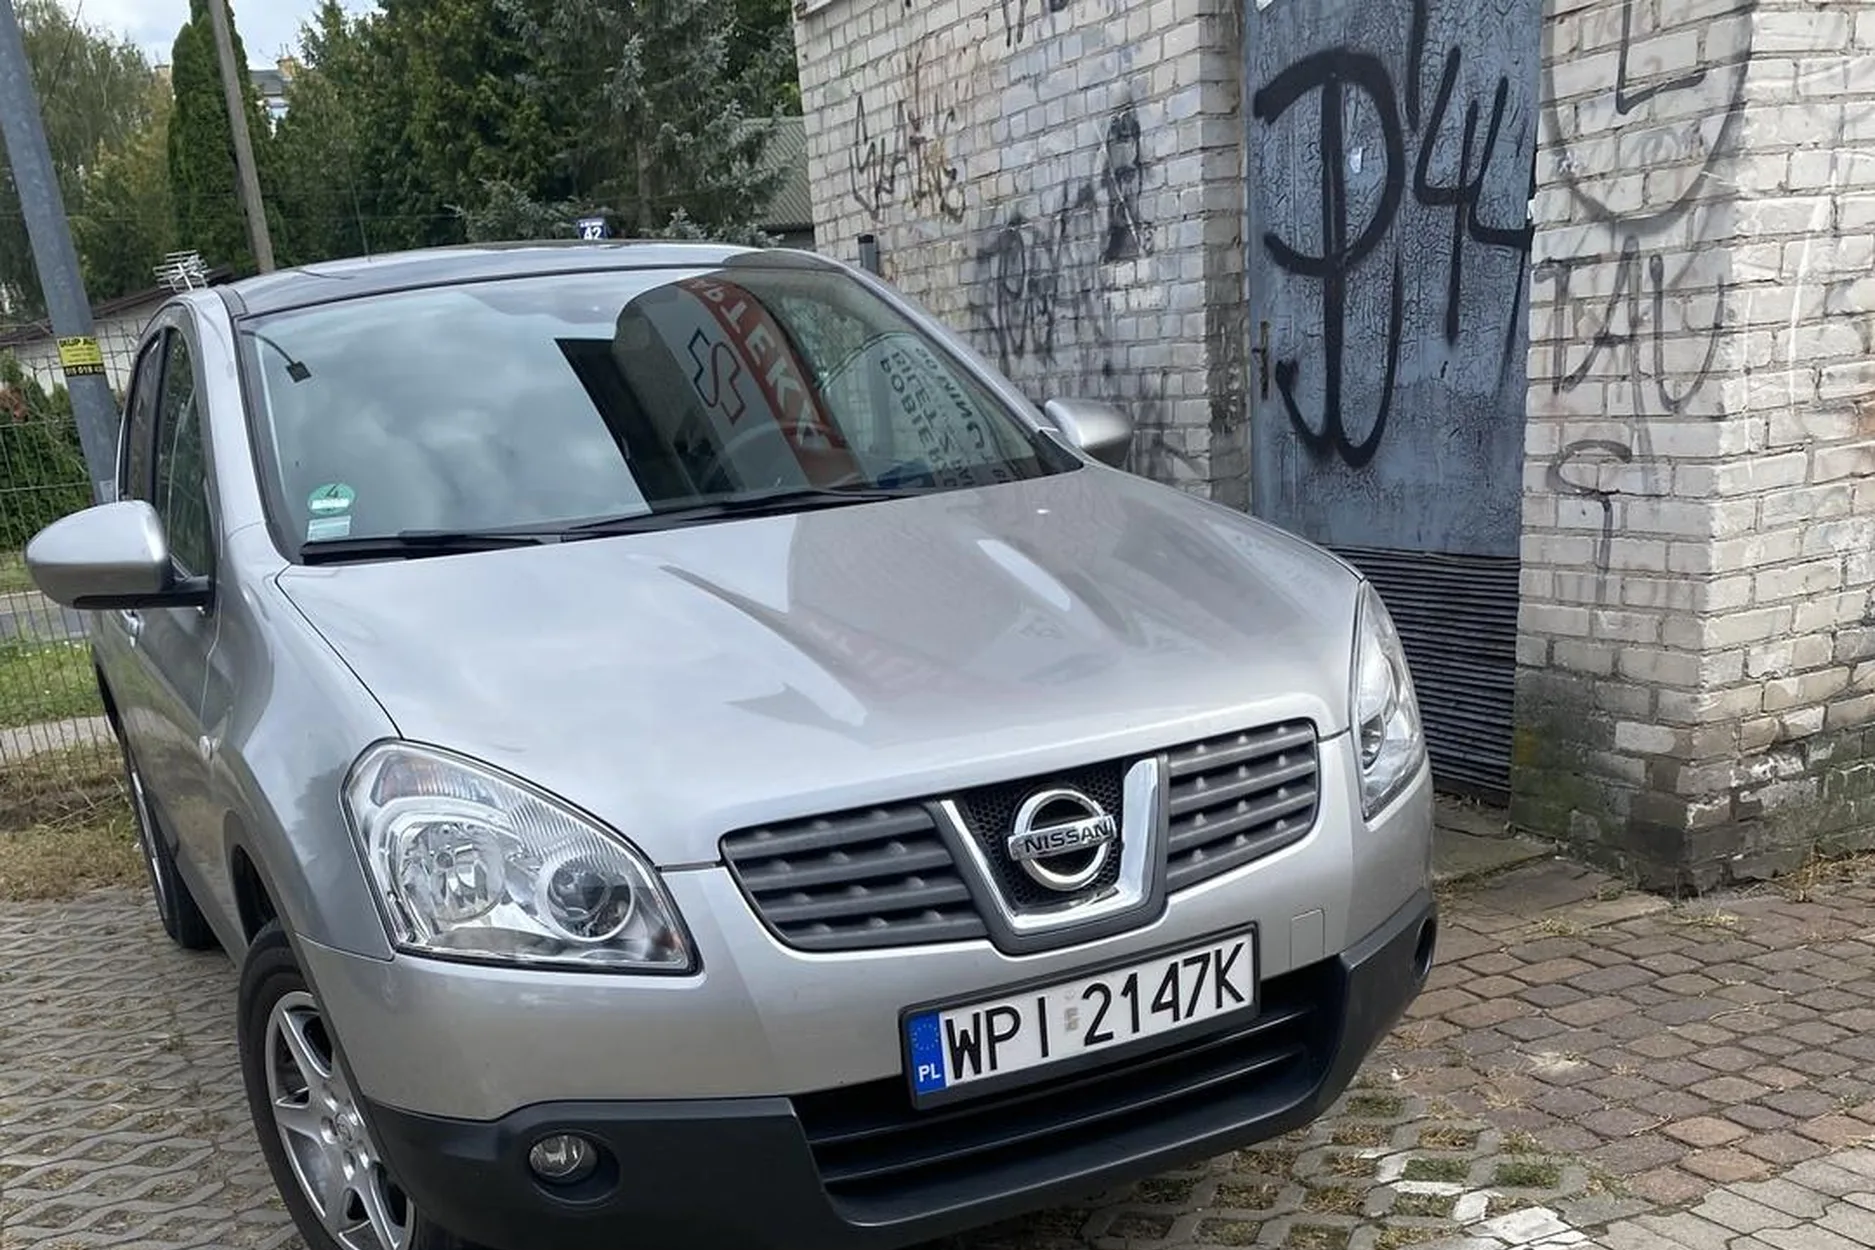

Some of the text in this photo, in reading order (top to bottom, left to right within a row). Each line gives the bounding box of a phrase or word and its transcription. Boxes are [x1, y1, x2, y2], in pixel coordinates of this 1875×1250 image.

[584, 227, 603, 240] 42
[325, 485, 339, 498] 4
[1024, 821, 1110, 853] NISSAN
[946, 941, 1246, 1080] WPI 2147K
[918, 1065, 941, 1082] PL
